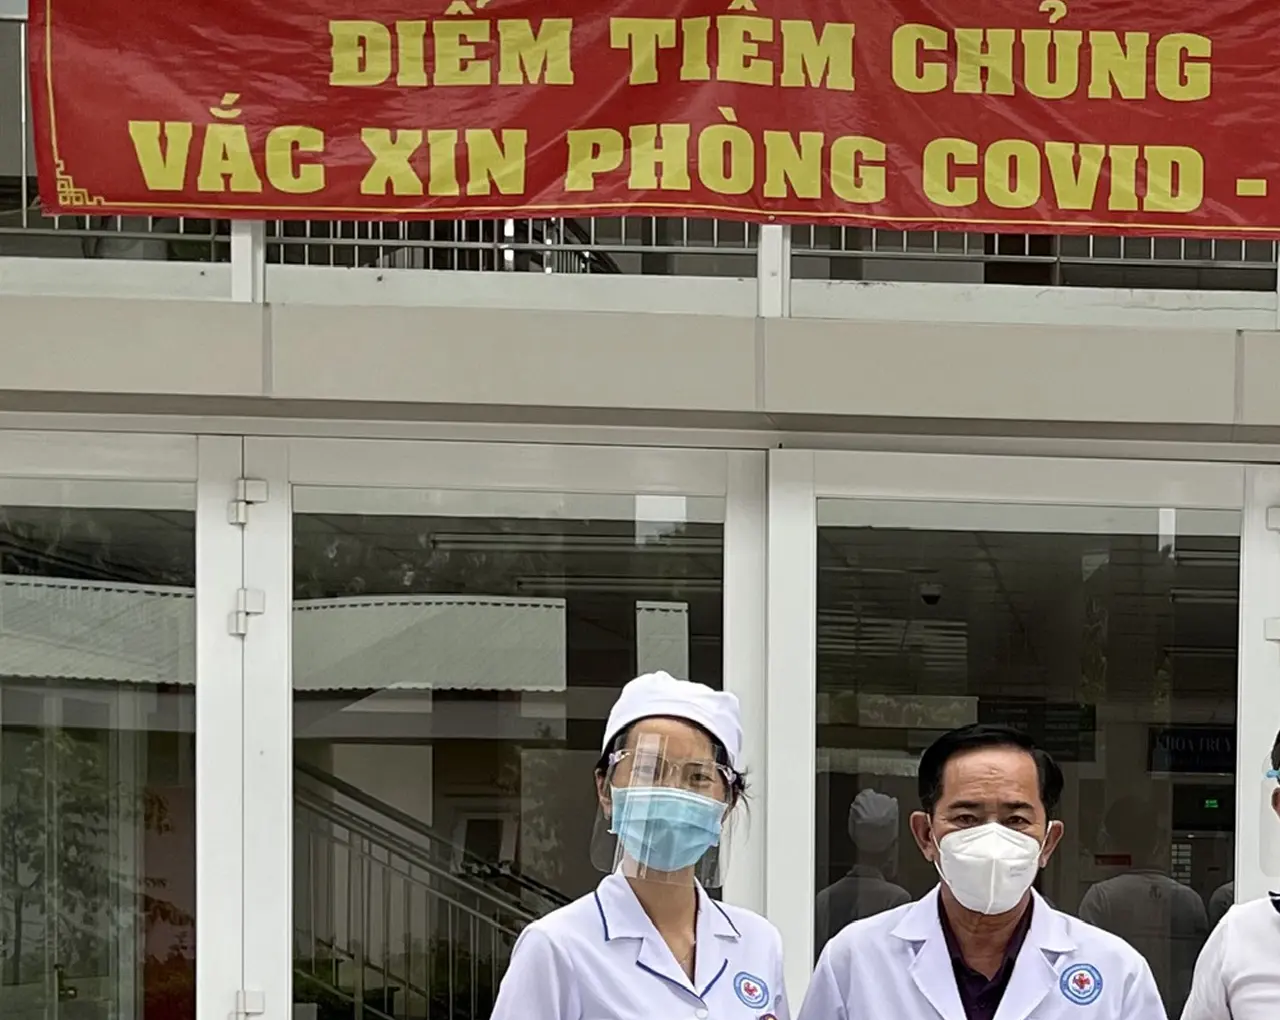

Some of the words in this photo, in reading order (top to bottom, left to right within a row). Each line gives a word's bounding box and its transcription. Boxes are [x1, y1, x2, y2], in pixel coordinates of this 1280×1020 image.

[610, 0, 855, 91] TIÊM
[892, 0, 1212, 101] CHỦNG
[129, 93, 325, 194] VẮC
[361, 128, 527, 196] XIN
[564, 107, 886, 204] PHÒNG
[923, 138, 1204, 212] COVID
[1237, 179, 1266, 196] -
